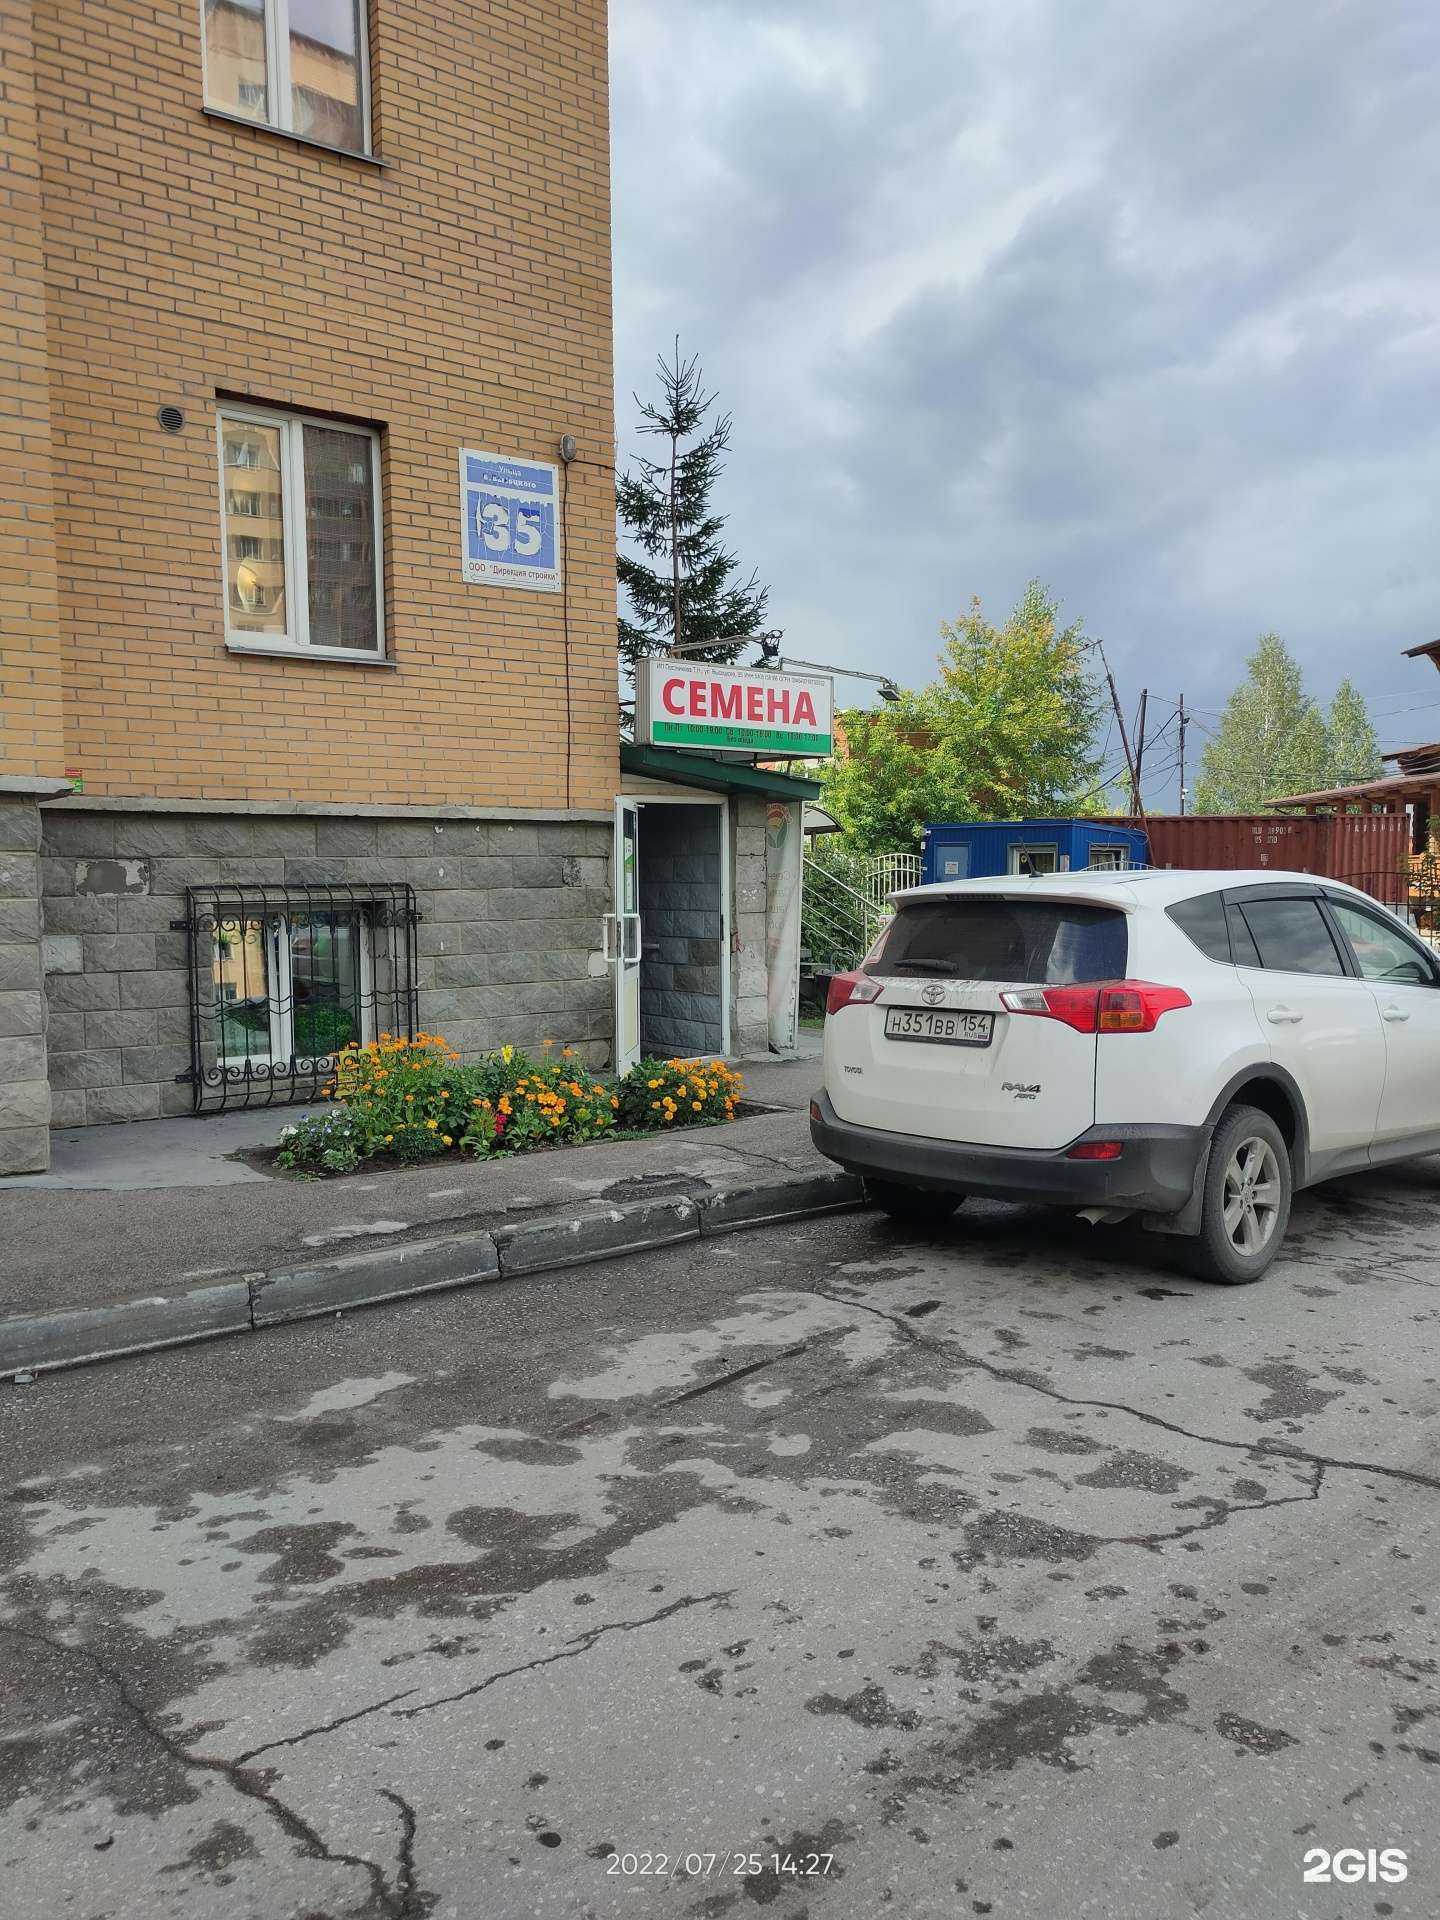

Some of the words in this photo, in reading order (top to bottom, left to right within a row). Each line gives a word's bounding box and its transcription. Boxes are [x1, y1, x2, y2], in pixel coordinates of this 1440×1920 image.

[499, 465, 521, 476] Улица
[481, 503, 542, 556] 35
[468, 562, 486, 572] ООО
[662, 678, 817, 727] СЕМЕНА
[961, 1015, 985, 1032] 154
[1001, 1081, 1041, 1093] RAV4
